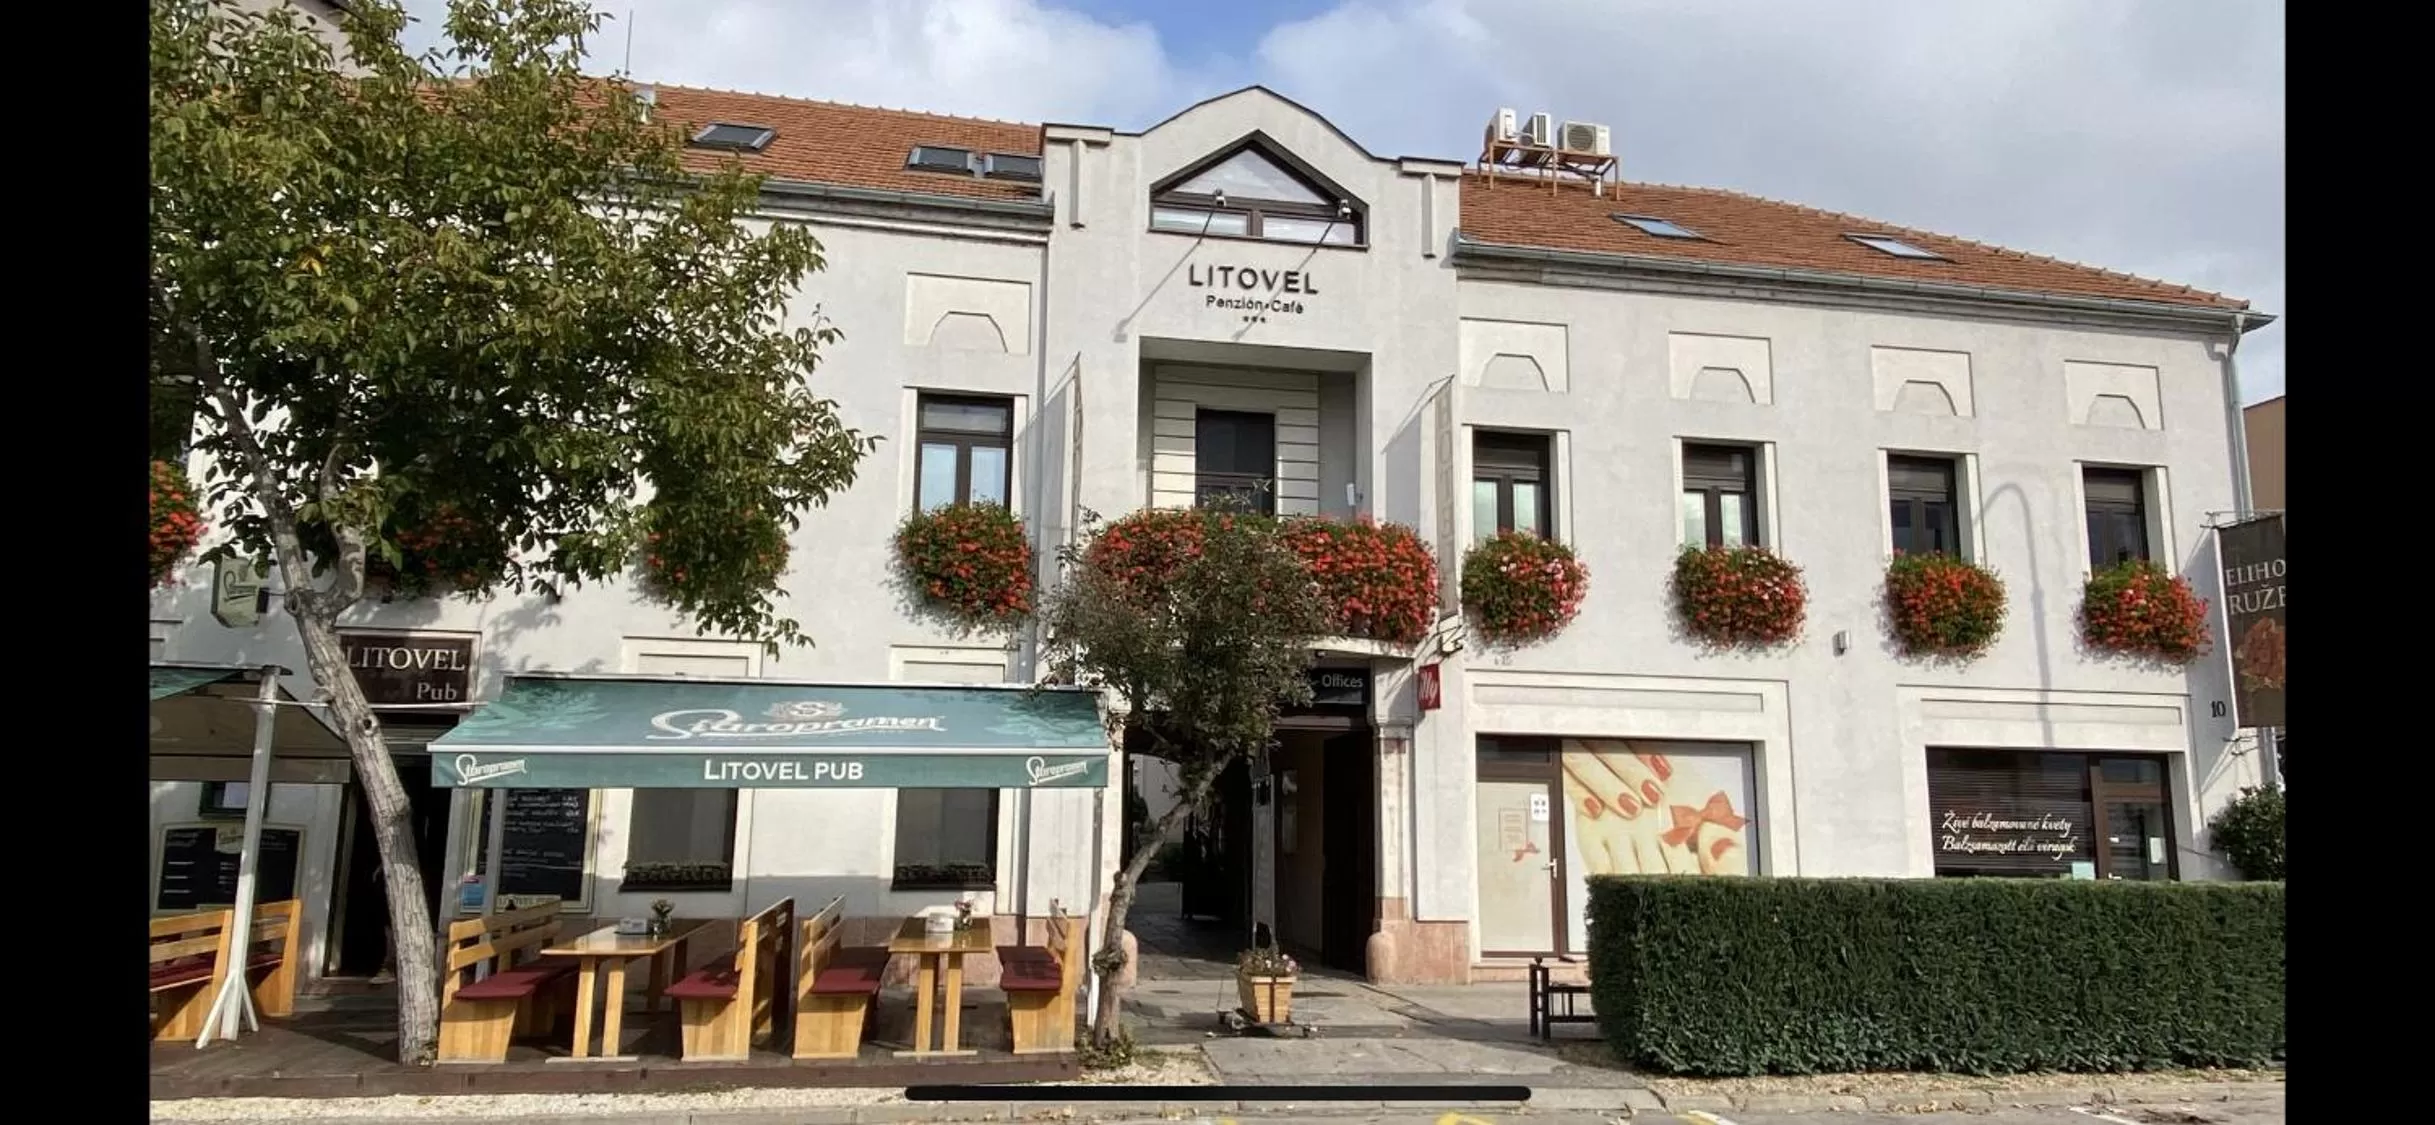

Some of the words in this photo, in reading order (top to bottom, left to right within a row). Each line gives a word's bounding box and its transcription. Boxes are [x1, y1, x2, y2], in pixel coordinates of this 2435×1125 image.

[1188, 263, 1319, 295] LITOVEL
[346, 645, 466, 672] LITOVEL
[416, 681, 458, 702] Pub
[1321, 673, 1364, 689] Offices
[2210, 700, 2227, 718] 10
[645, 708, 949, 741] Staropramen
[703, 758, 809, 782] LITOVEL
[813, 760, 864, 781] PUB
